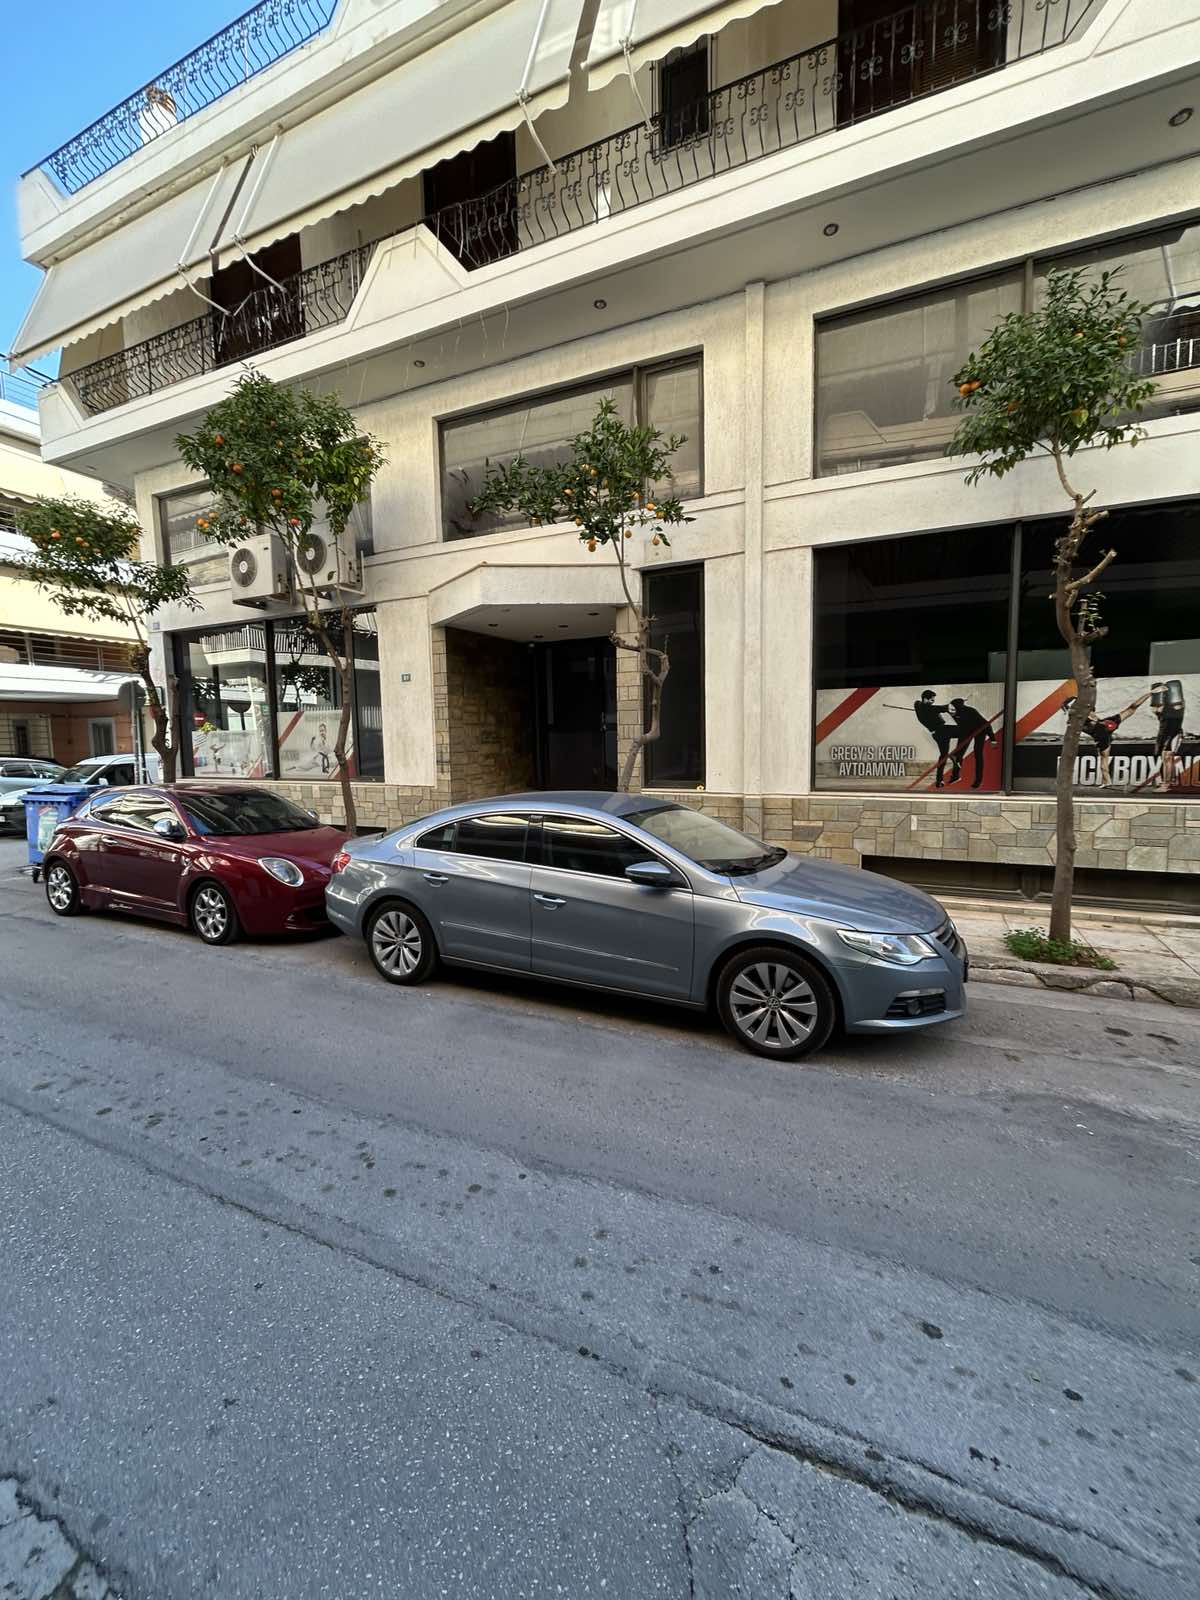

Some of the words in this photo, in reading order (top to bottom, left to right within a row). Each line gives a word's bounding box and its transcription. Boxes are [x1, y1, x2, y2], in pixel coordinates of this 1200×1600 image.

[831, 746, 874, 760] GREGY'S
[878, 746, 915, 760] KENPO
[1057, 755, 1200, 786] ICKBOXN
